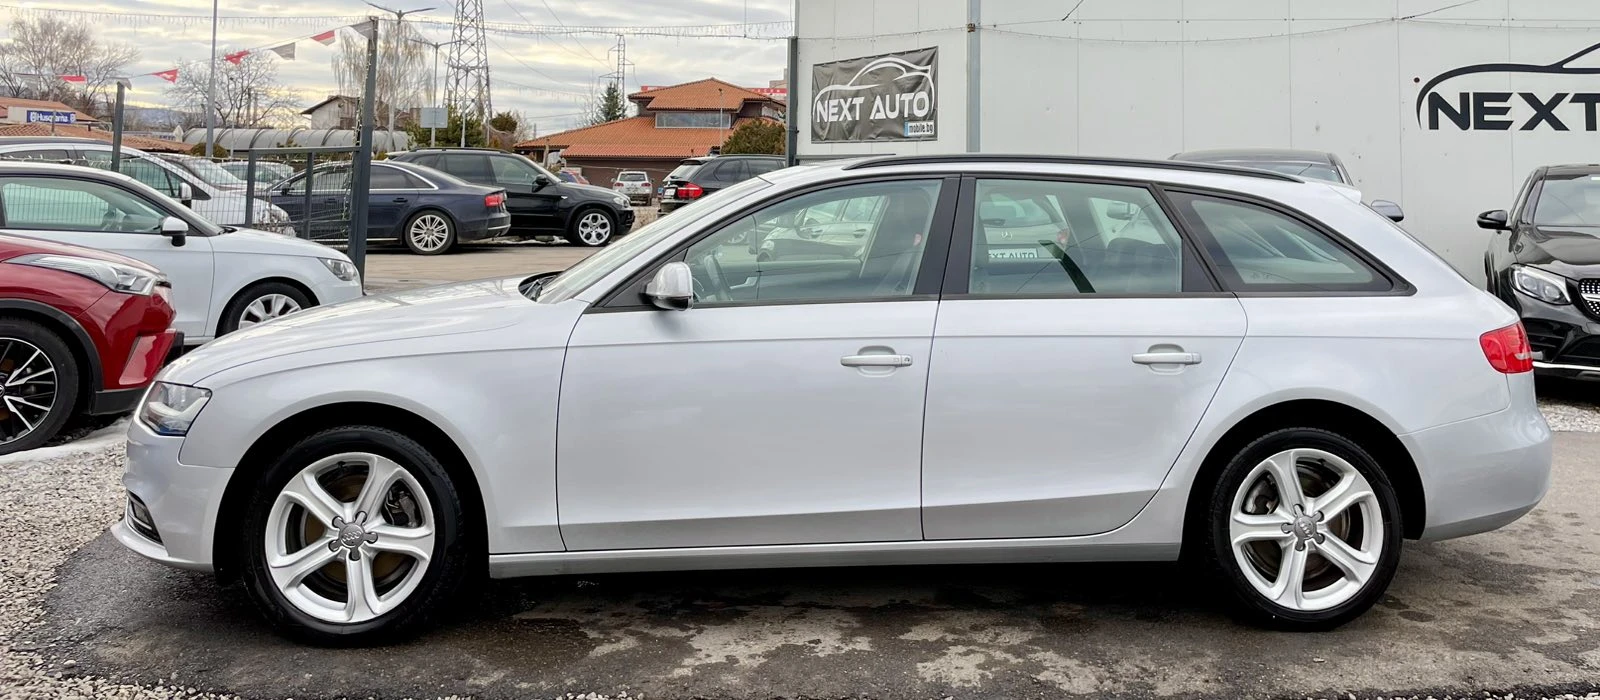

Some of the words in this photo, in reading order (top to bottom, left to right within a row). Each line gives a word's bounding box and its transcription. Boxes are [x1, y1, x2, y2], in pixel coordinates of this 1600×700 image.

[816, 96, 865, 123] NEXT
[869, 91, 930, 120] AUTO
[1428, 91, 1600, 131] NEXT
[909, 123, 934, 133] mobile.bg
